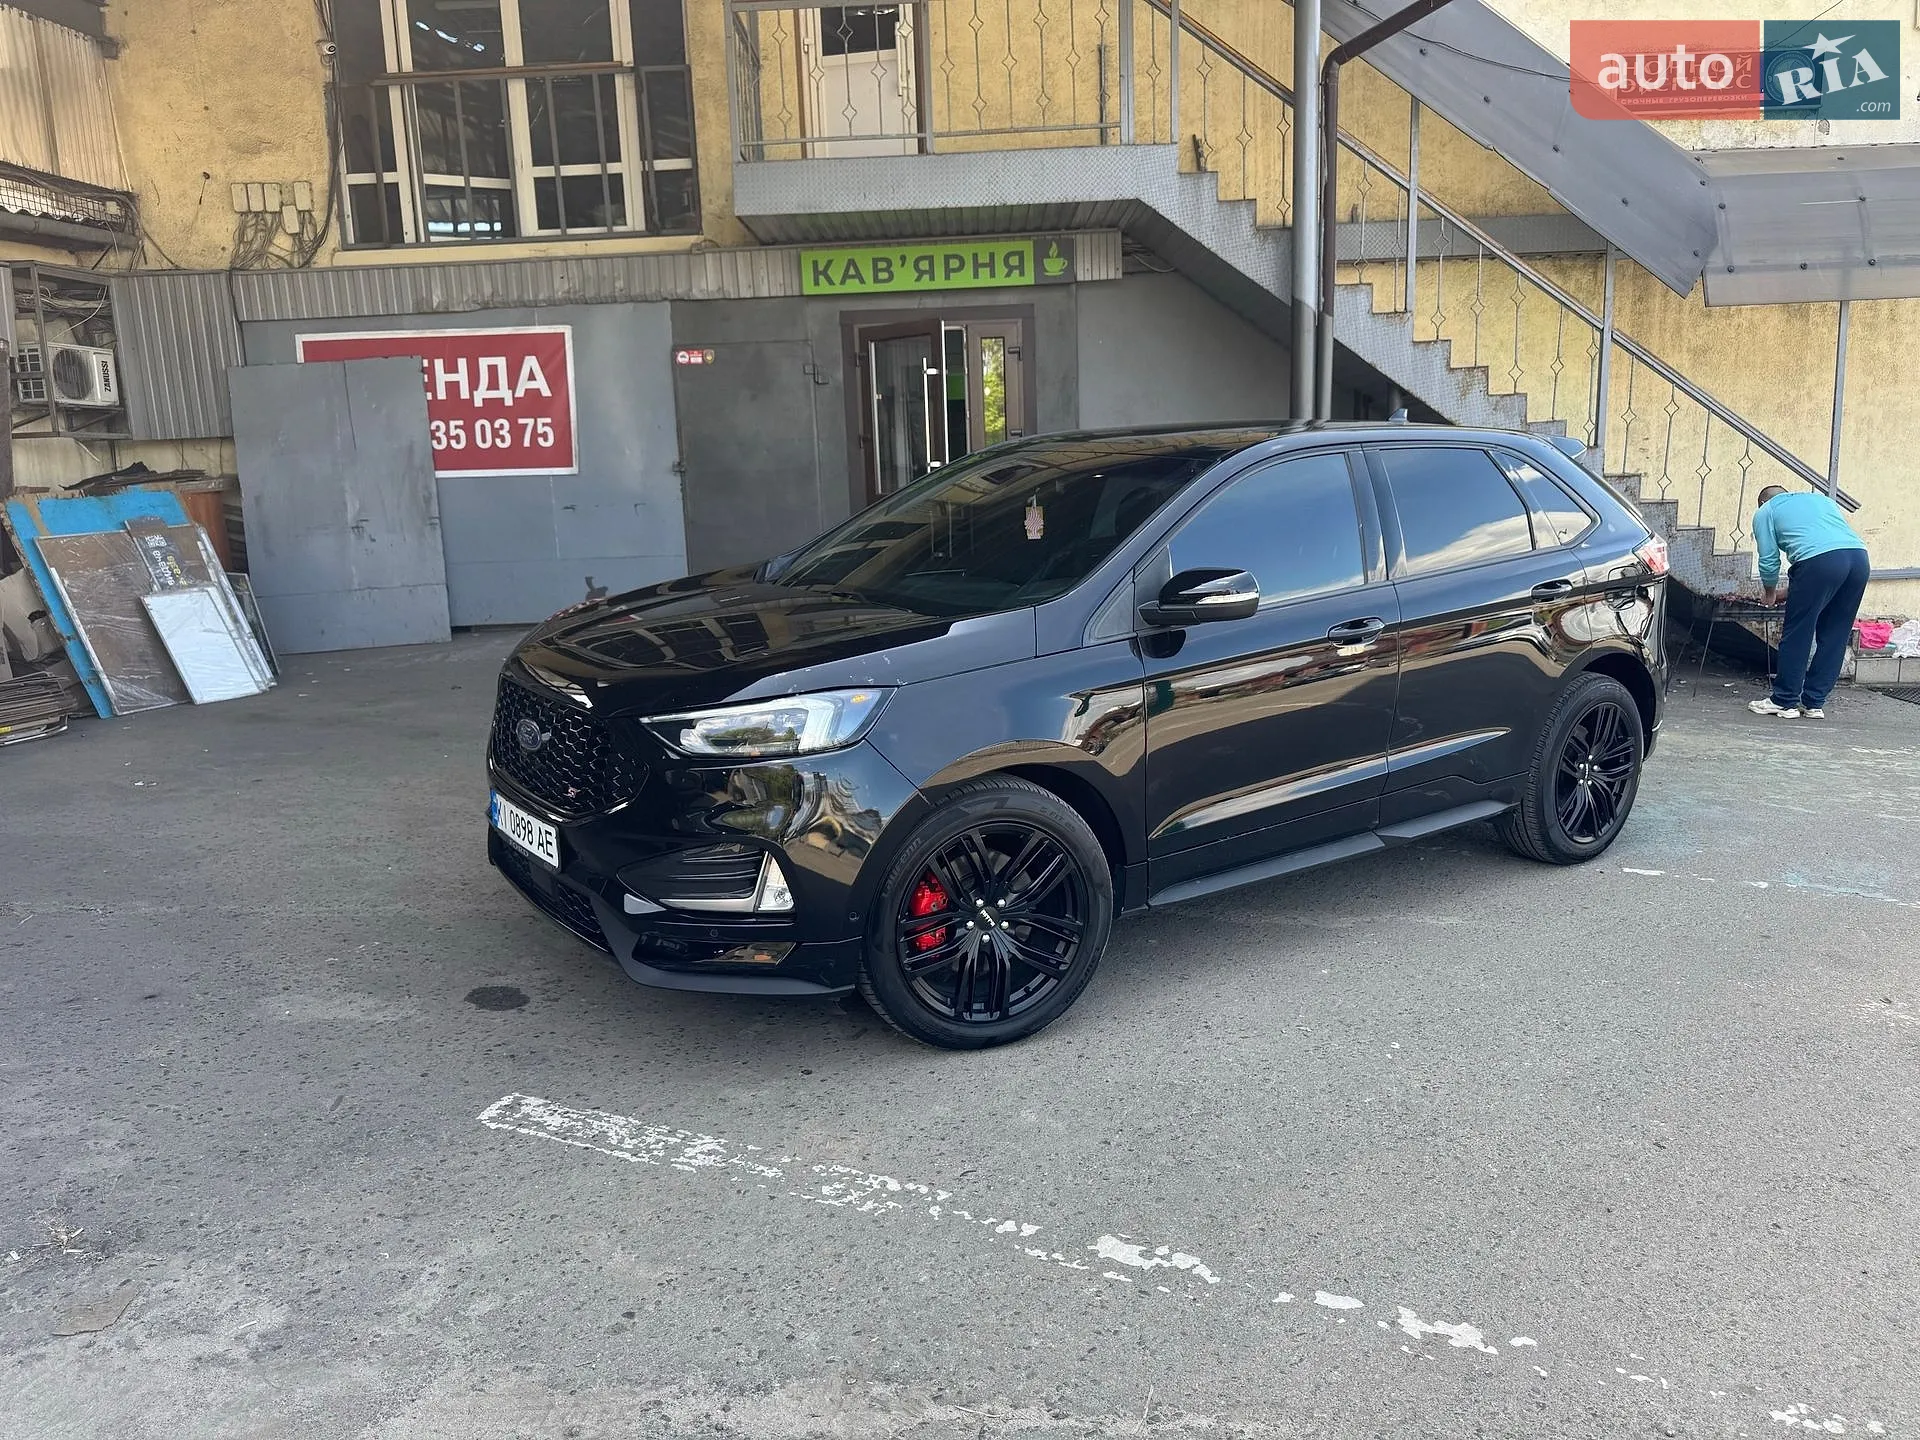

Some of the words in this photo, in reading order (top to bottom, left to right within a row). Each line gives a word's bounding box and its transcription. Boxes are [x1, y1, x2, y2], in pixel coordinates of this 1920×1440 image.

[812, 250, 1025, 287] КАВ’ЯРНЯ
[101, 360, 111, 392] ZANUSSI
[423, 355, 552, 407] НДА
[474, 418, 512, 449] 03
[517, 417, 555, 448] 75
[510, 809, 534, 846] 0898
[537, 825, 554, 859] AE
